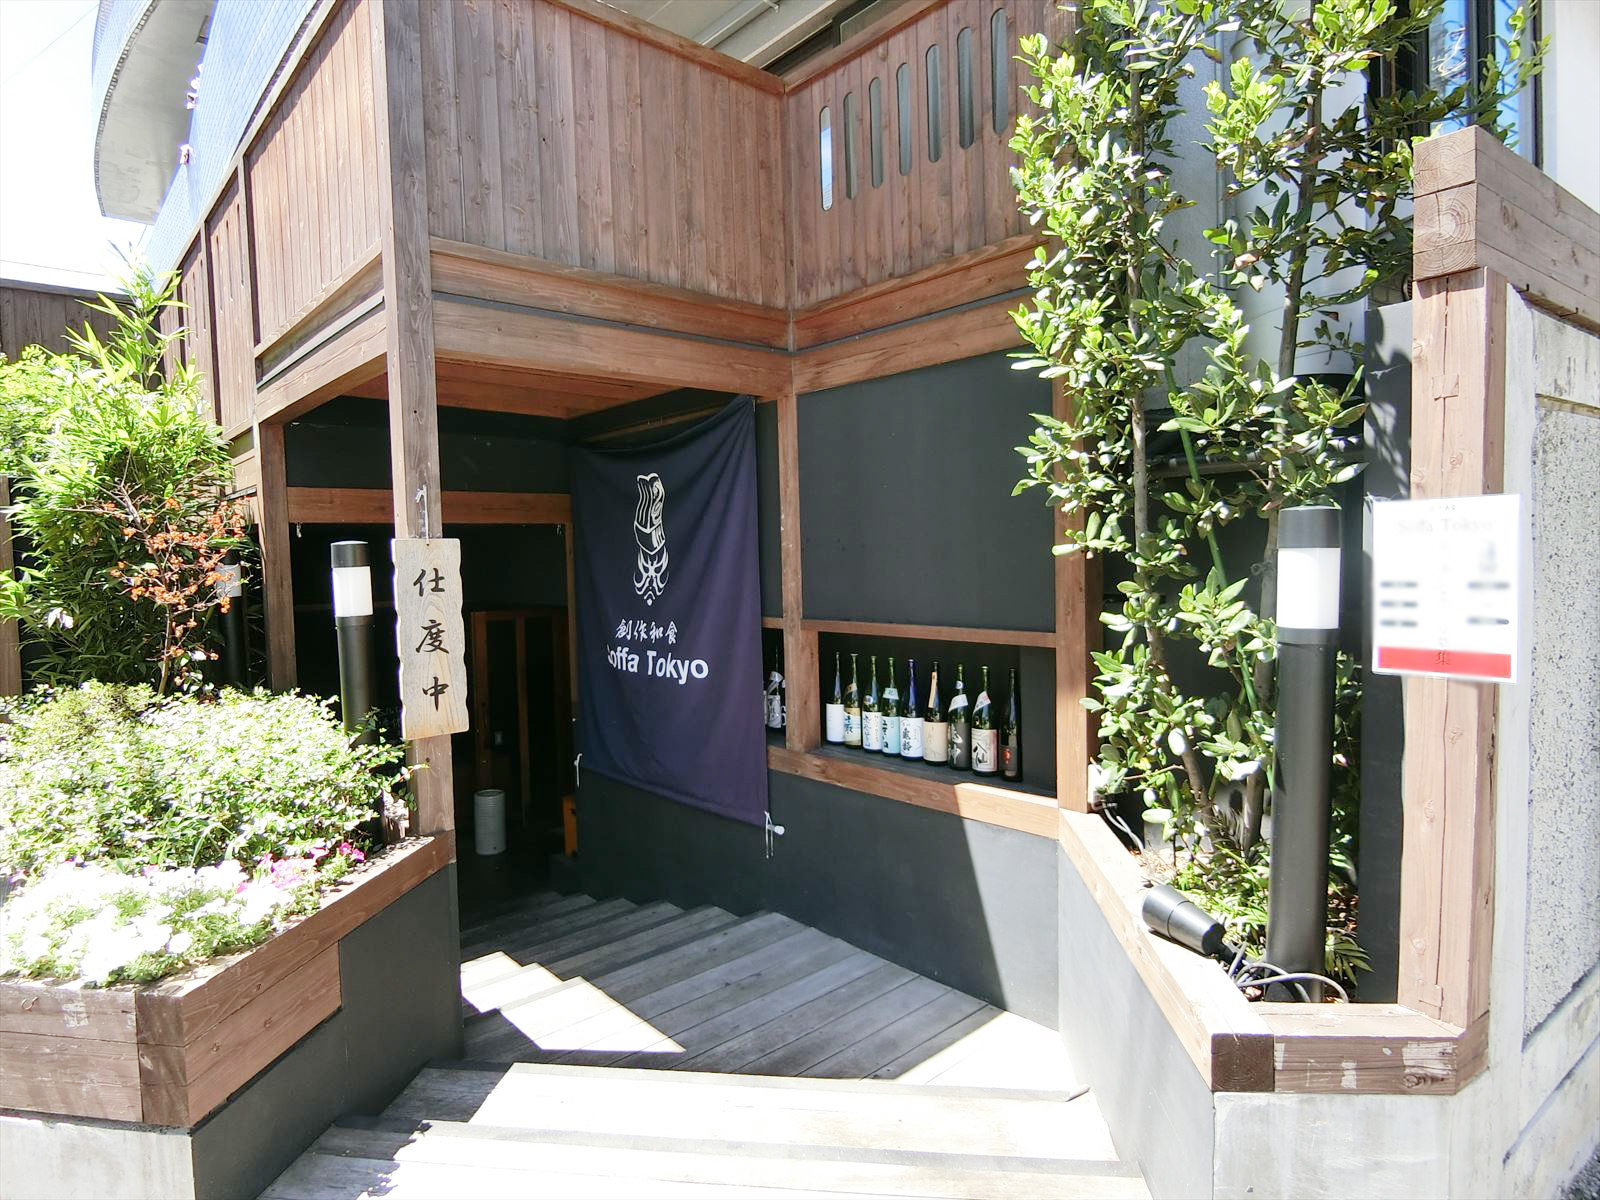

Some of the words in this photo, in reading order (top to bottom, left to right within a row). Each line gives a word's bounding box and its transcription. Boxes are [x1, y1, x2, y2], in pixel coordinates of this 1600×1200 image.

[413, 567, 449, 712] 仕度中
[615, 618, 678, 645] 創作和食
[646, 650, 709, 685] Tokyo
